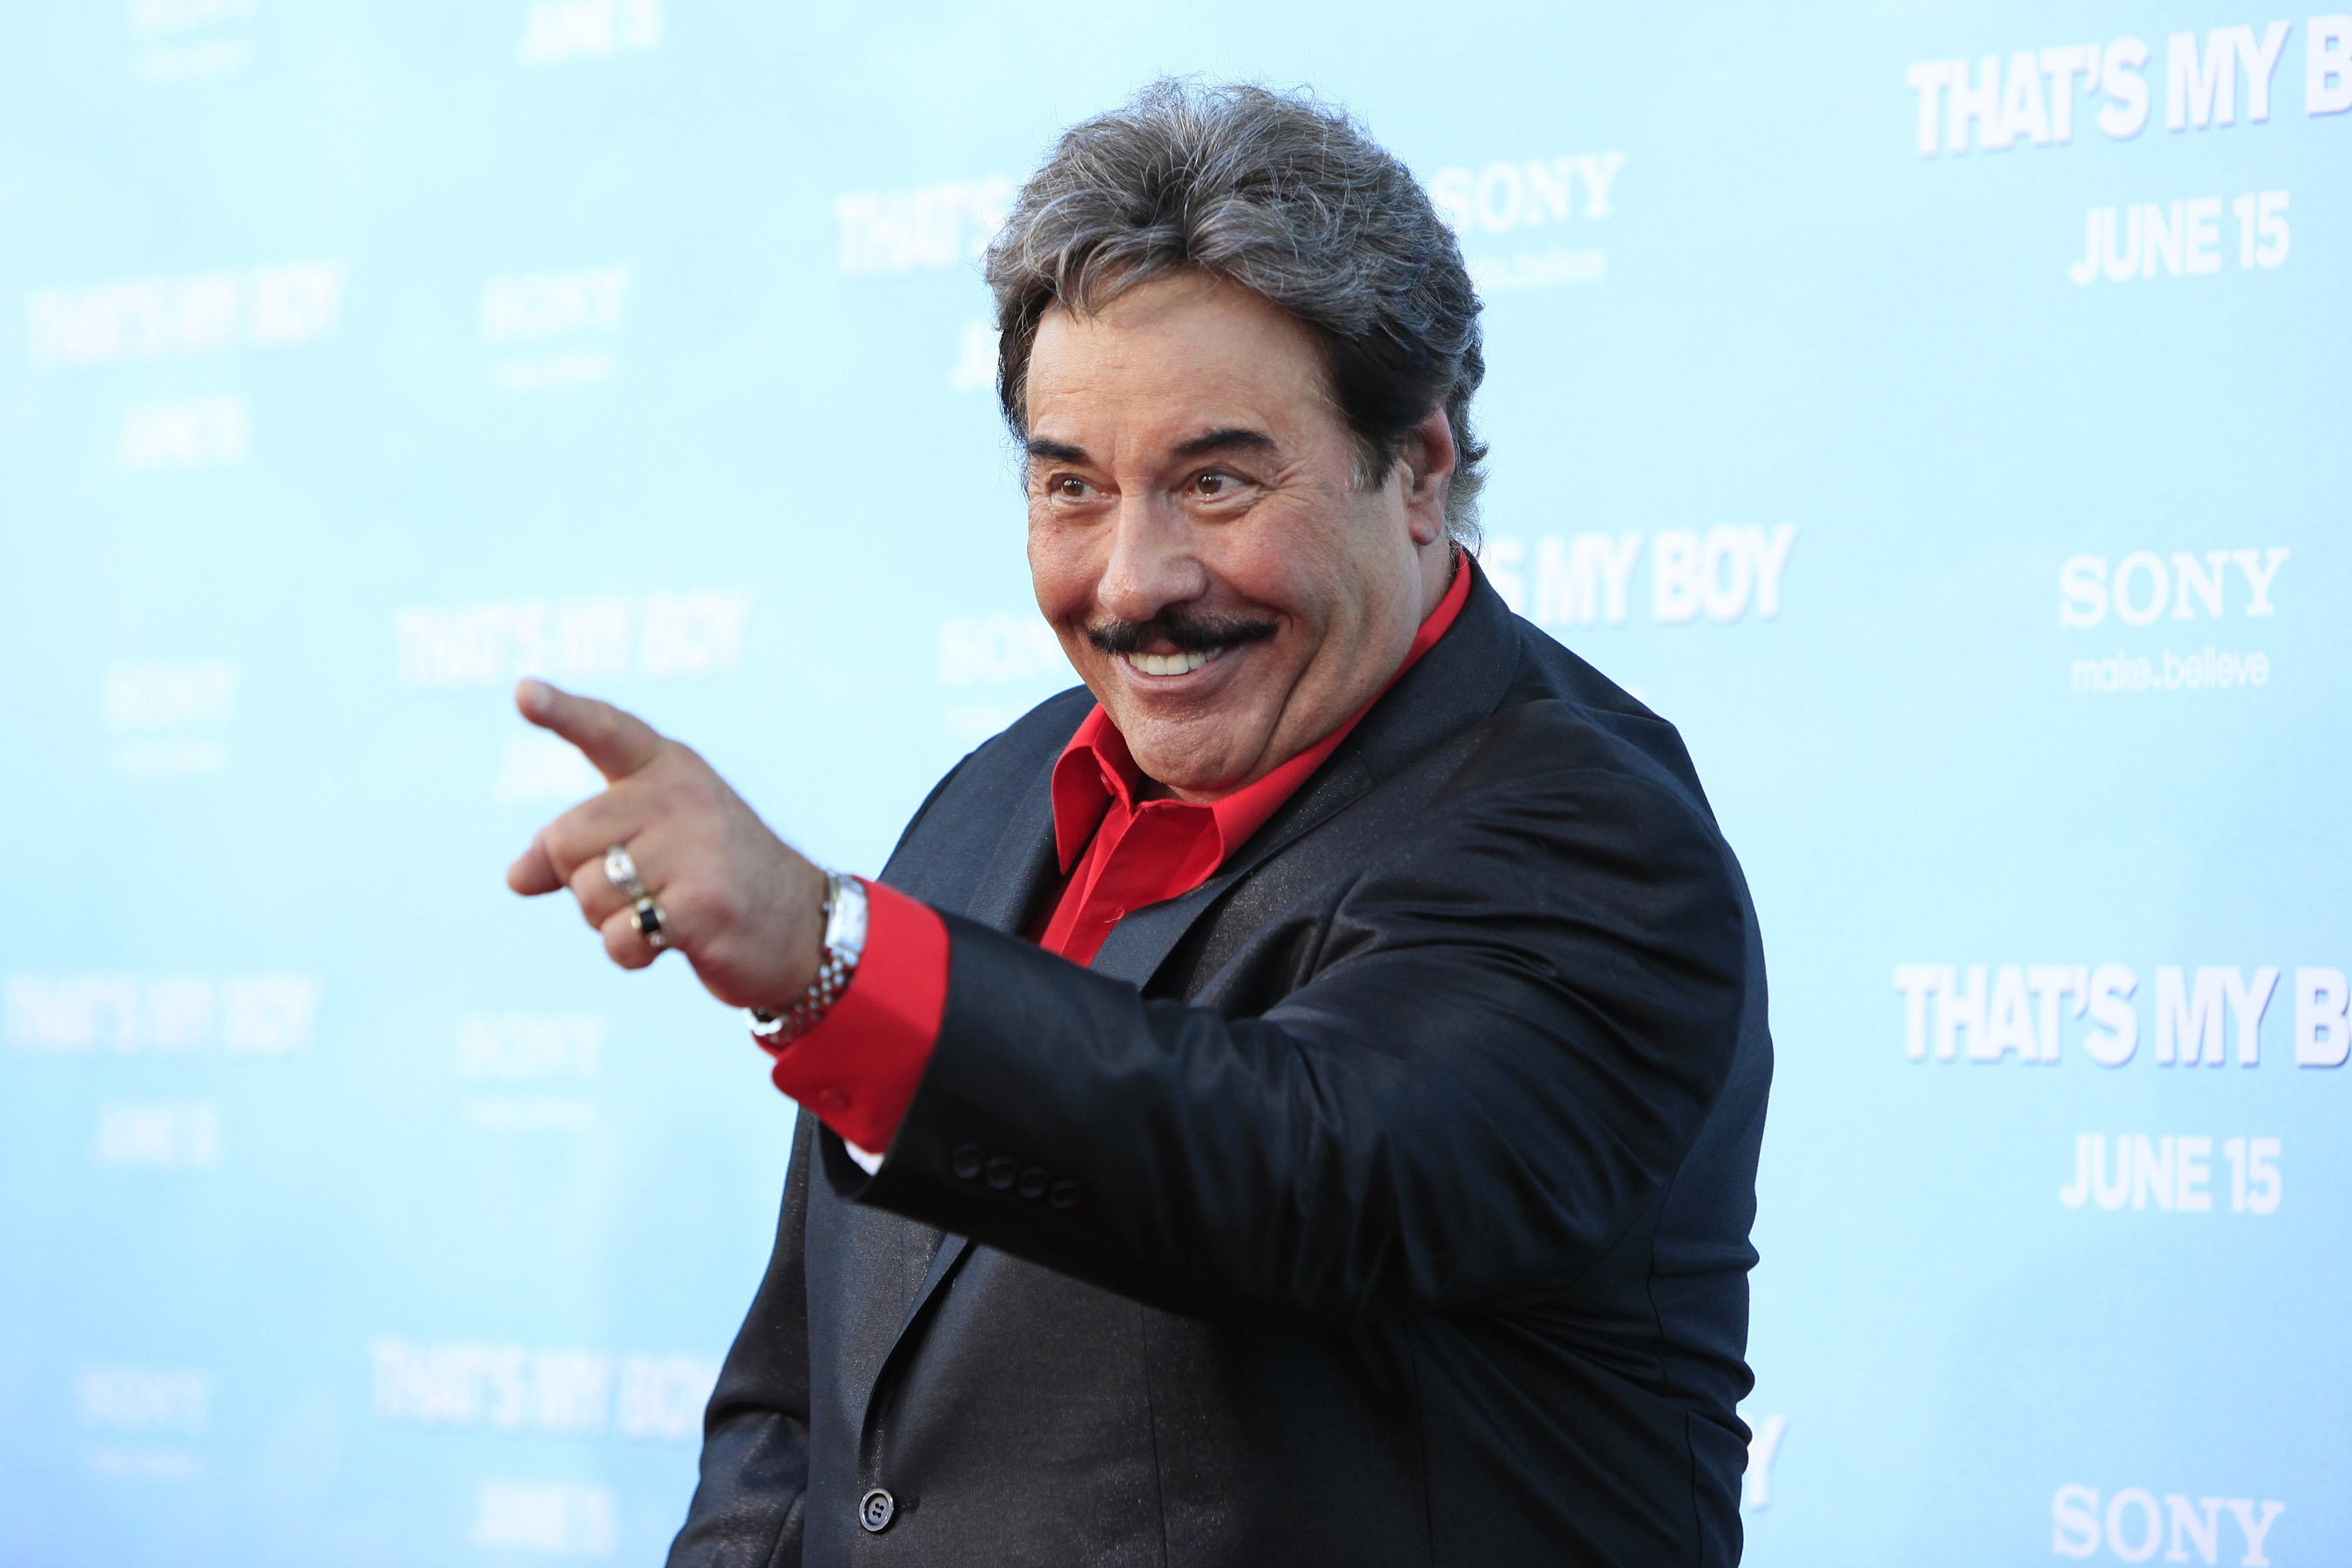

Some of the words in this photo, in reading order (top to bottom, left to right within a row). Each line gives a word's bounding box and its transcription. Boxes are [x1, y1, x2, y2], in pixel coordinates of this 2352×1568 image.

[1907, 37, 2150, 156] THAT'S
[2166, 20, 2290, 131] MY
[1430, 151, 1625, 233] SONY
[2069, 197, 2222, 286] JUNE
[2232, 190, 2291, 270] 15
[1535, 531, 1643, 627] MY
[1653, 523, 1797, 622] BOY
[2059, 546, 2291, 629] SONY
[2071, 646, 2271, 693] make.believe
[1894, 963, 2139, 1068] THAT'S
[2155, 966, 2280, 1067] MY
[2058, 1132, 2213, 1212] JUNE
[2223, 1135, 2283, 1215] 15
[2051, 1483, 2287, 1568] SONY
